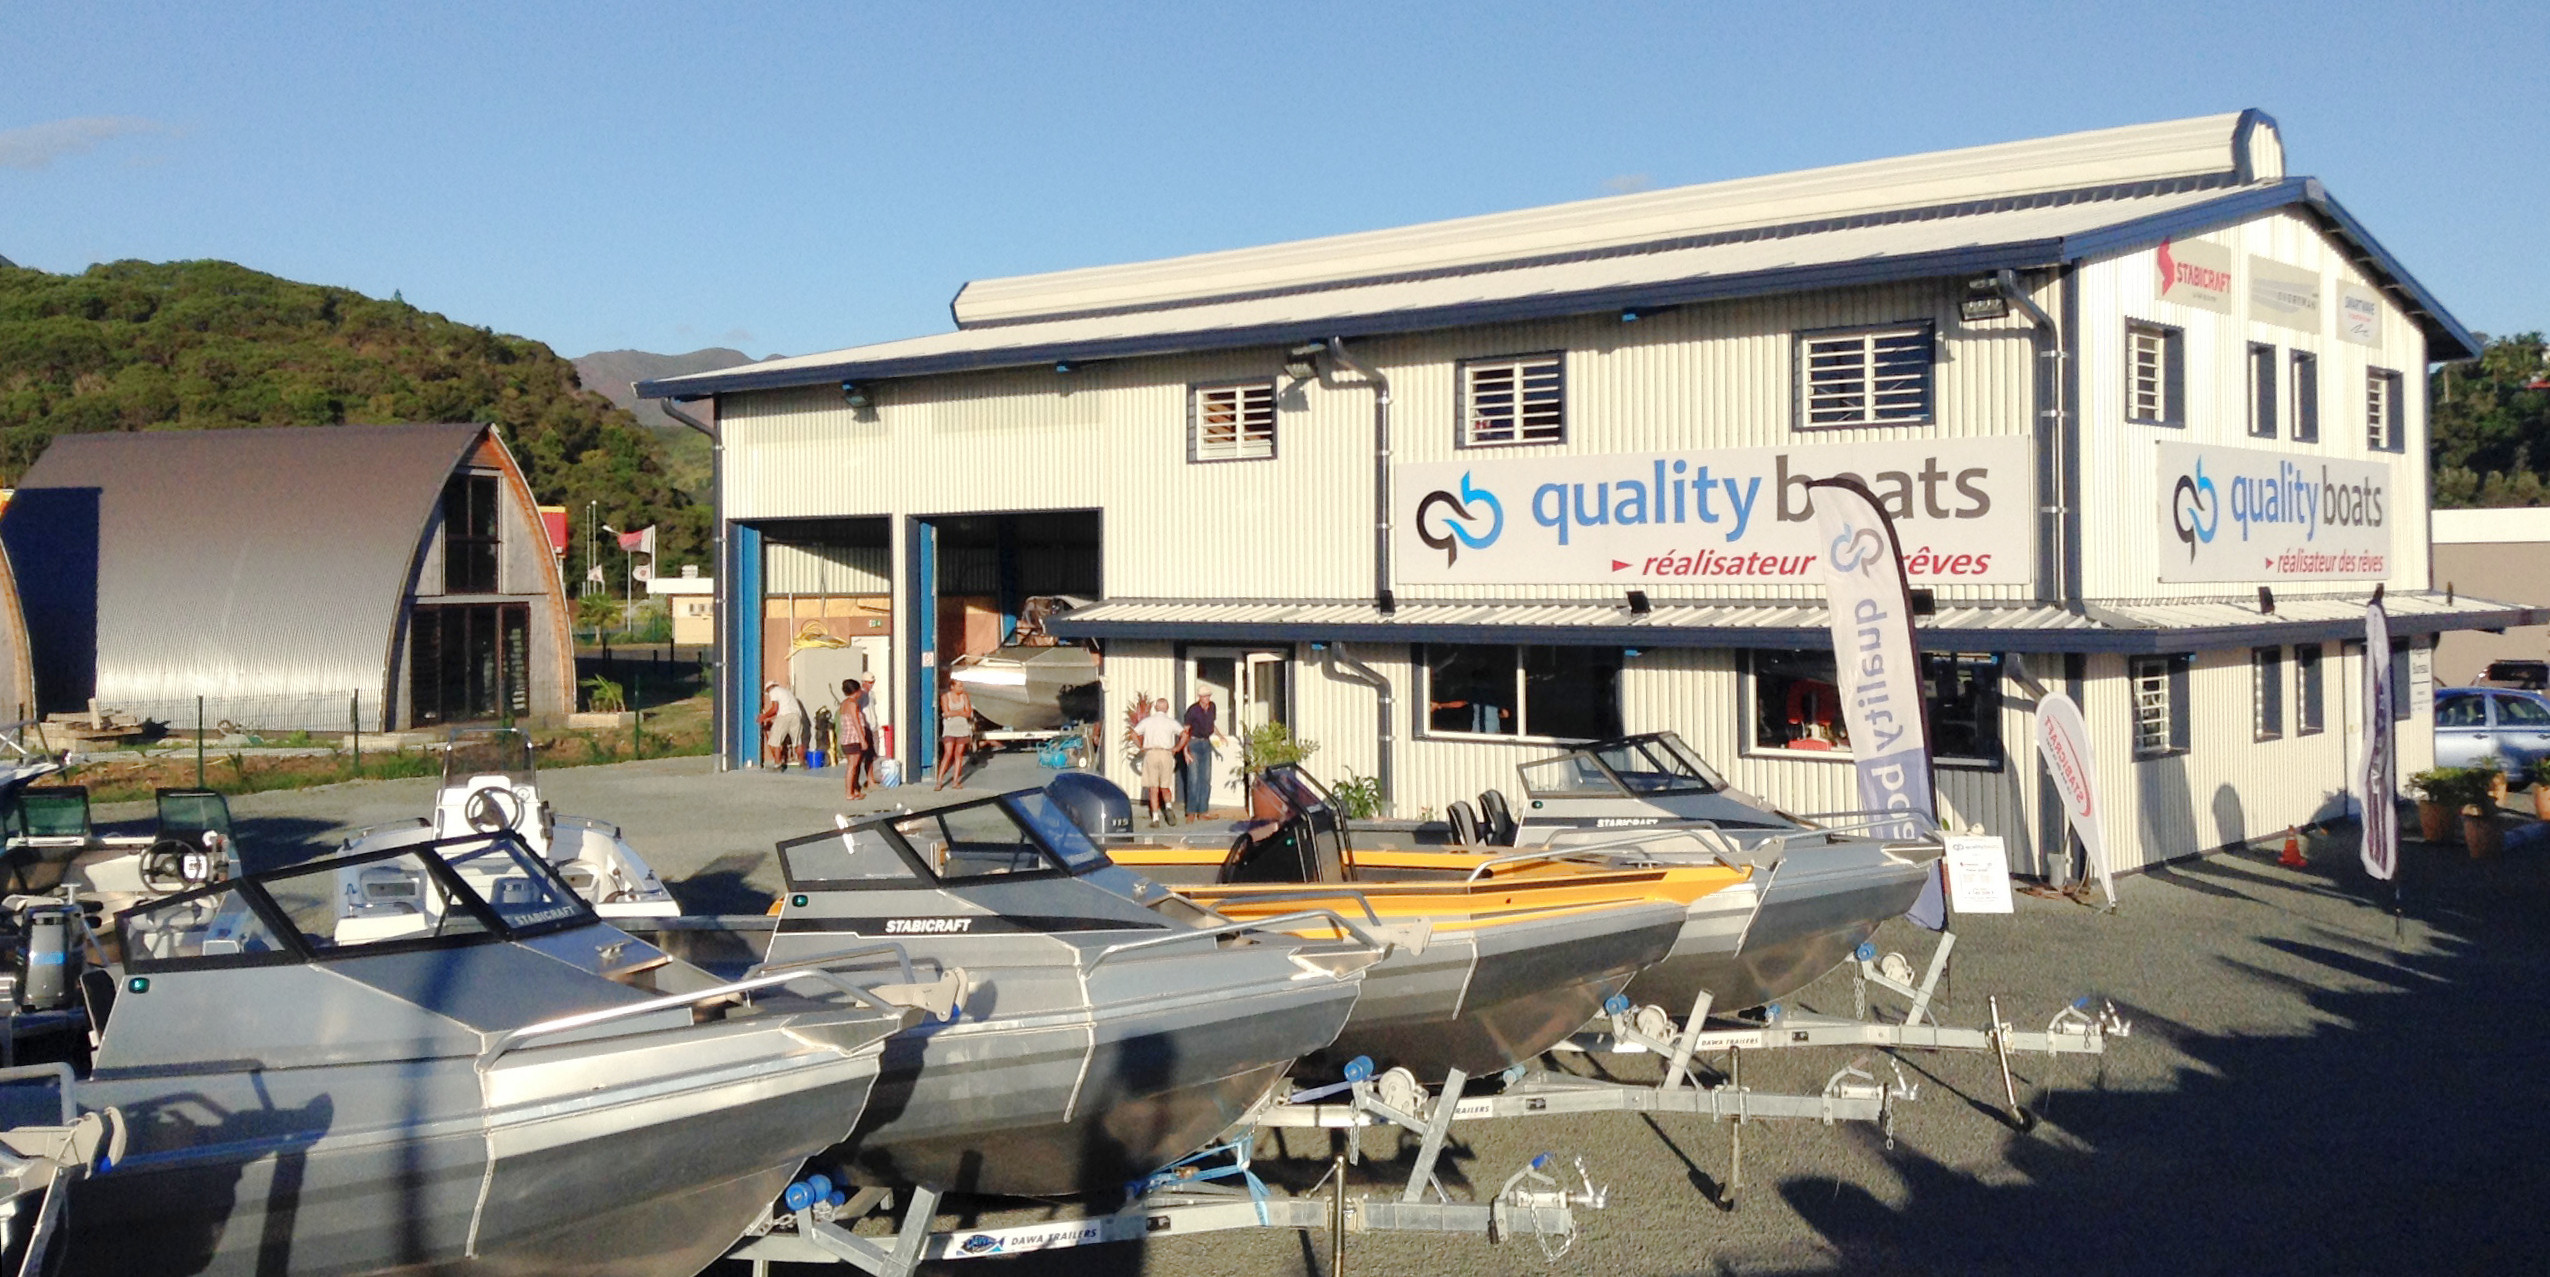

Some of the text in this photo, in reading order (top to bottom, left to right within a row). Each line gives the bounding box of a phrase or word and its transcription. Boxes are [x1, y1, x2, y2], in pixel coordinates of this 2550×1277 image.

[2177, 262, 2230, 293] STABICRAFT
[1532, 454, 1991, 545] quality bats
[2231, 460, 2383, 542] quality boats
[1643, 546, 1992, 576] réalisateur êves
[2278, 548, 2384, 573] réalisateur des rêves
[514, 906, 574, 925] STABICRAFT
[885, 918, 972, 933] STABICRAFT
[1455, 1105, 1490, 1114] RAILERS
[1011, 1228, 1097, 1246] DAWA TRAILERS
